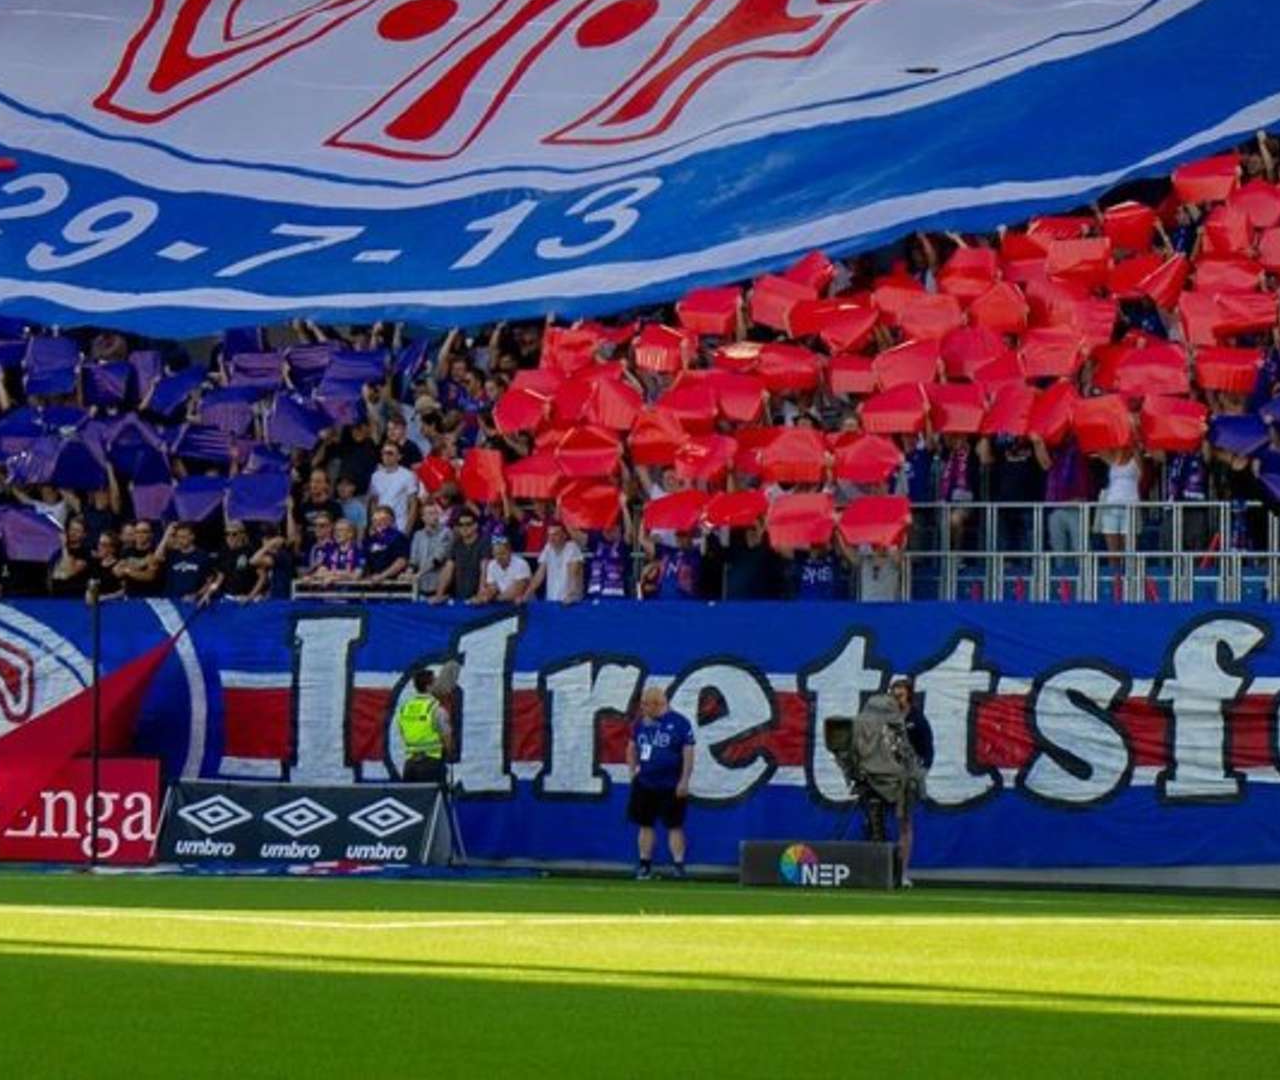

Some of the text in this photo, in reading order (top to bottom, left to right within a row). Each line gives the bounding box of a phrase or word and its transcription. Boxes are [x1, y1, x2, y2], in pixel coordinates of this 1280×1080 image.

[175, 837, 236, 857] umbro
[260, 840, 320, 860] umbro
[345, 841, 408, 861] umbro
[800, 863, 851, 886] NEP
